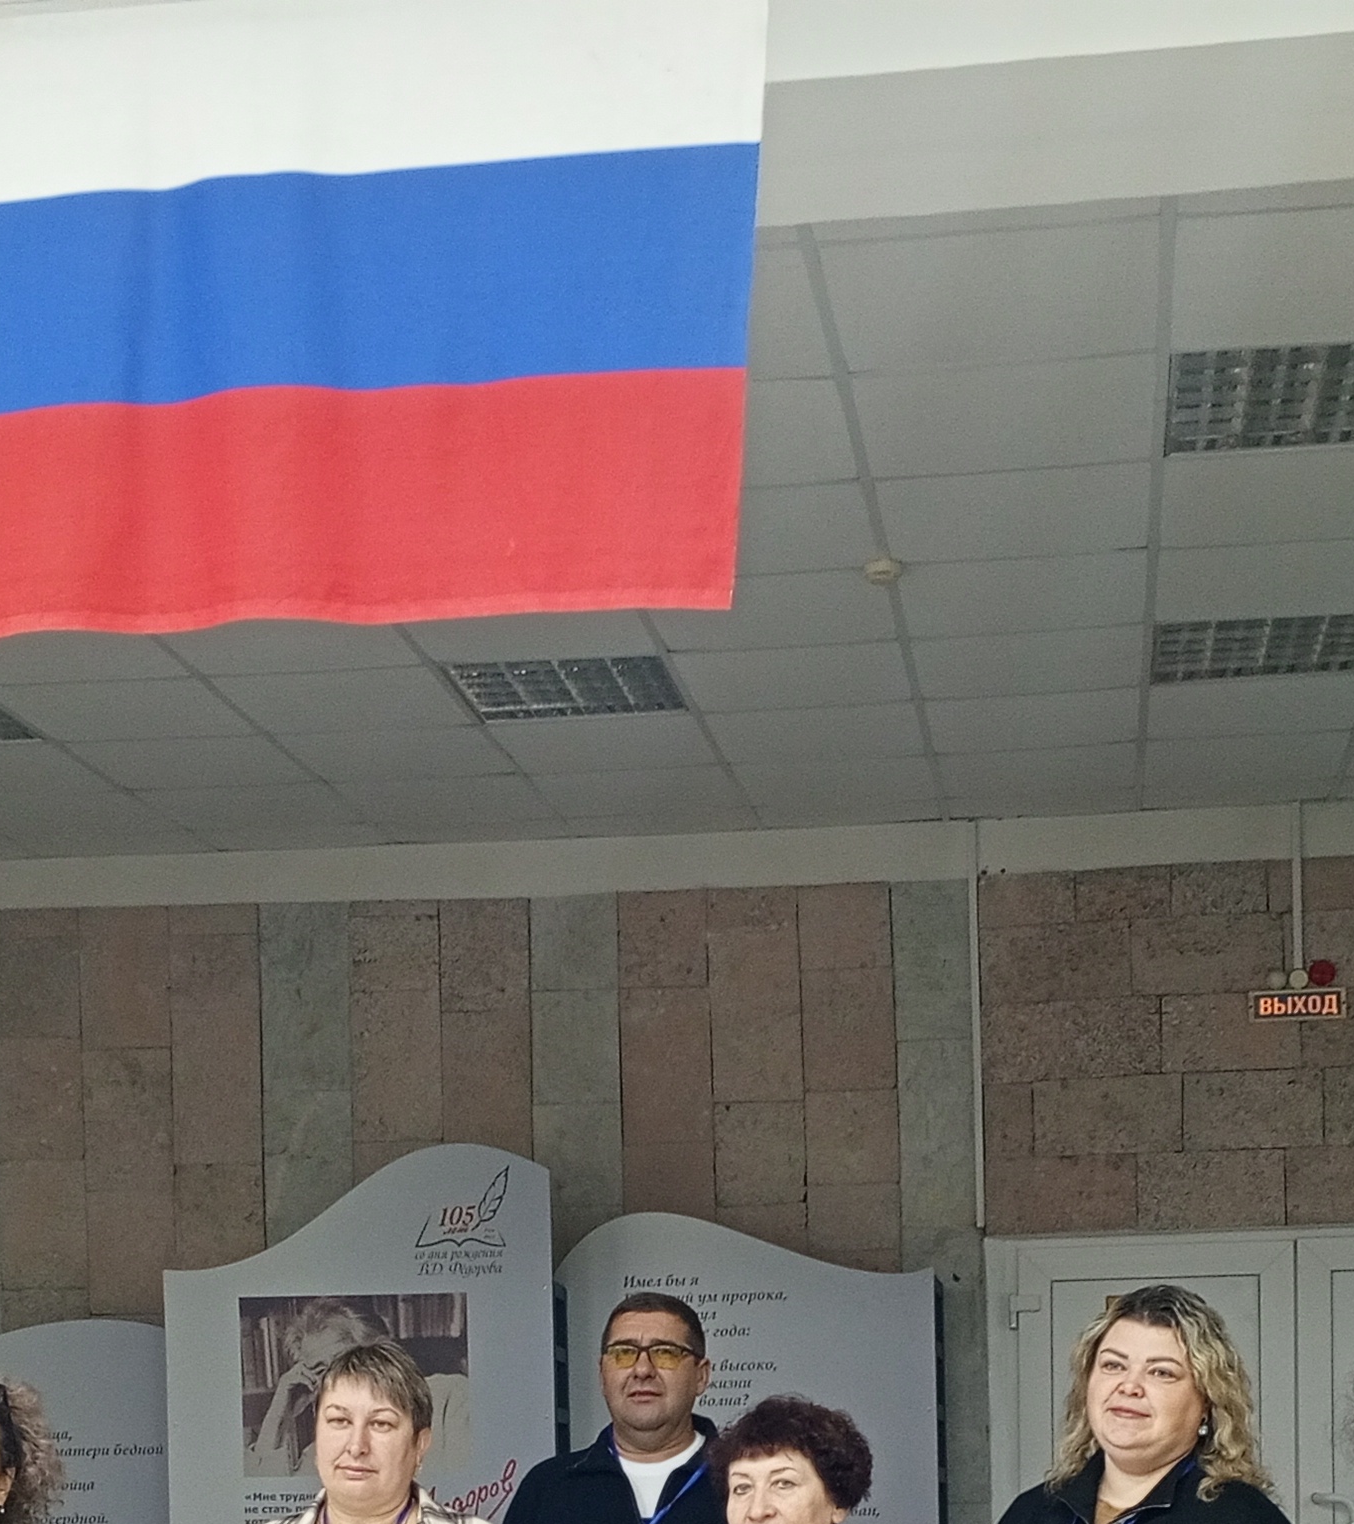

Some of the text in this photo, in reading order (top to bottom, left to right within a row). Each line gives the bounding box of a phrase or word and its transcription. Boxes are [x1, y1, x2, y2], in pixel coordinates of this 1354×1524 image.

[1259, 994, 1339, 1016] ВЫХОД
[439, 1205, 476, 1227] 105
[450, 1249, 503, 1261] рождения
[623, 1273, 699, 1288] Имел бы я
[697, 1293, 718, 1307] ум
[721, 1291, 787, 1306] пророка,
[713, 1324, 750, 1338] года:
[720, 1359, 777, 1372] высоко,
[699, 1394, 750, 1407] волна?
[113, 1442, 164, 1456] бедной
[244, 1492, 277, 1501] «Мне
[244, 1506, 259, 1514] не
[261, 1506, 293, 1514] стать
